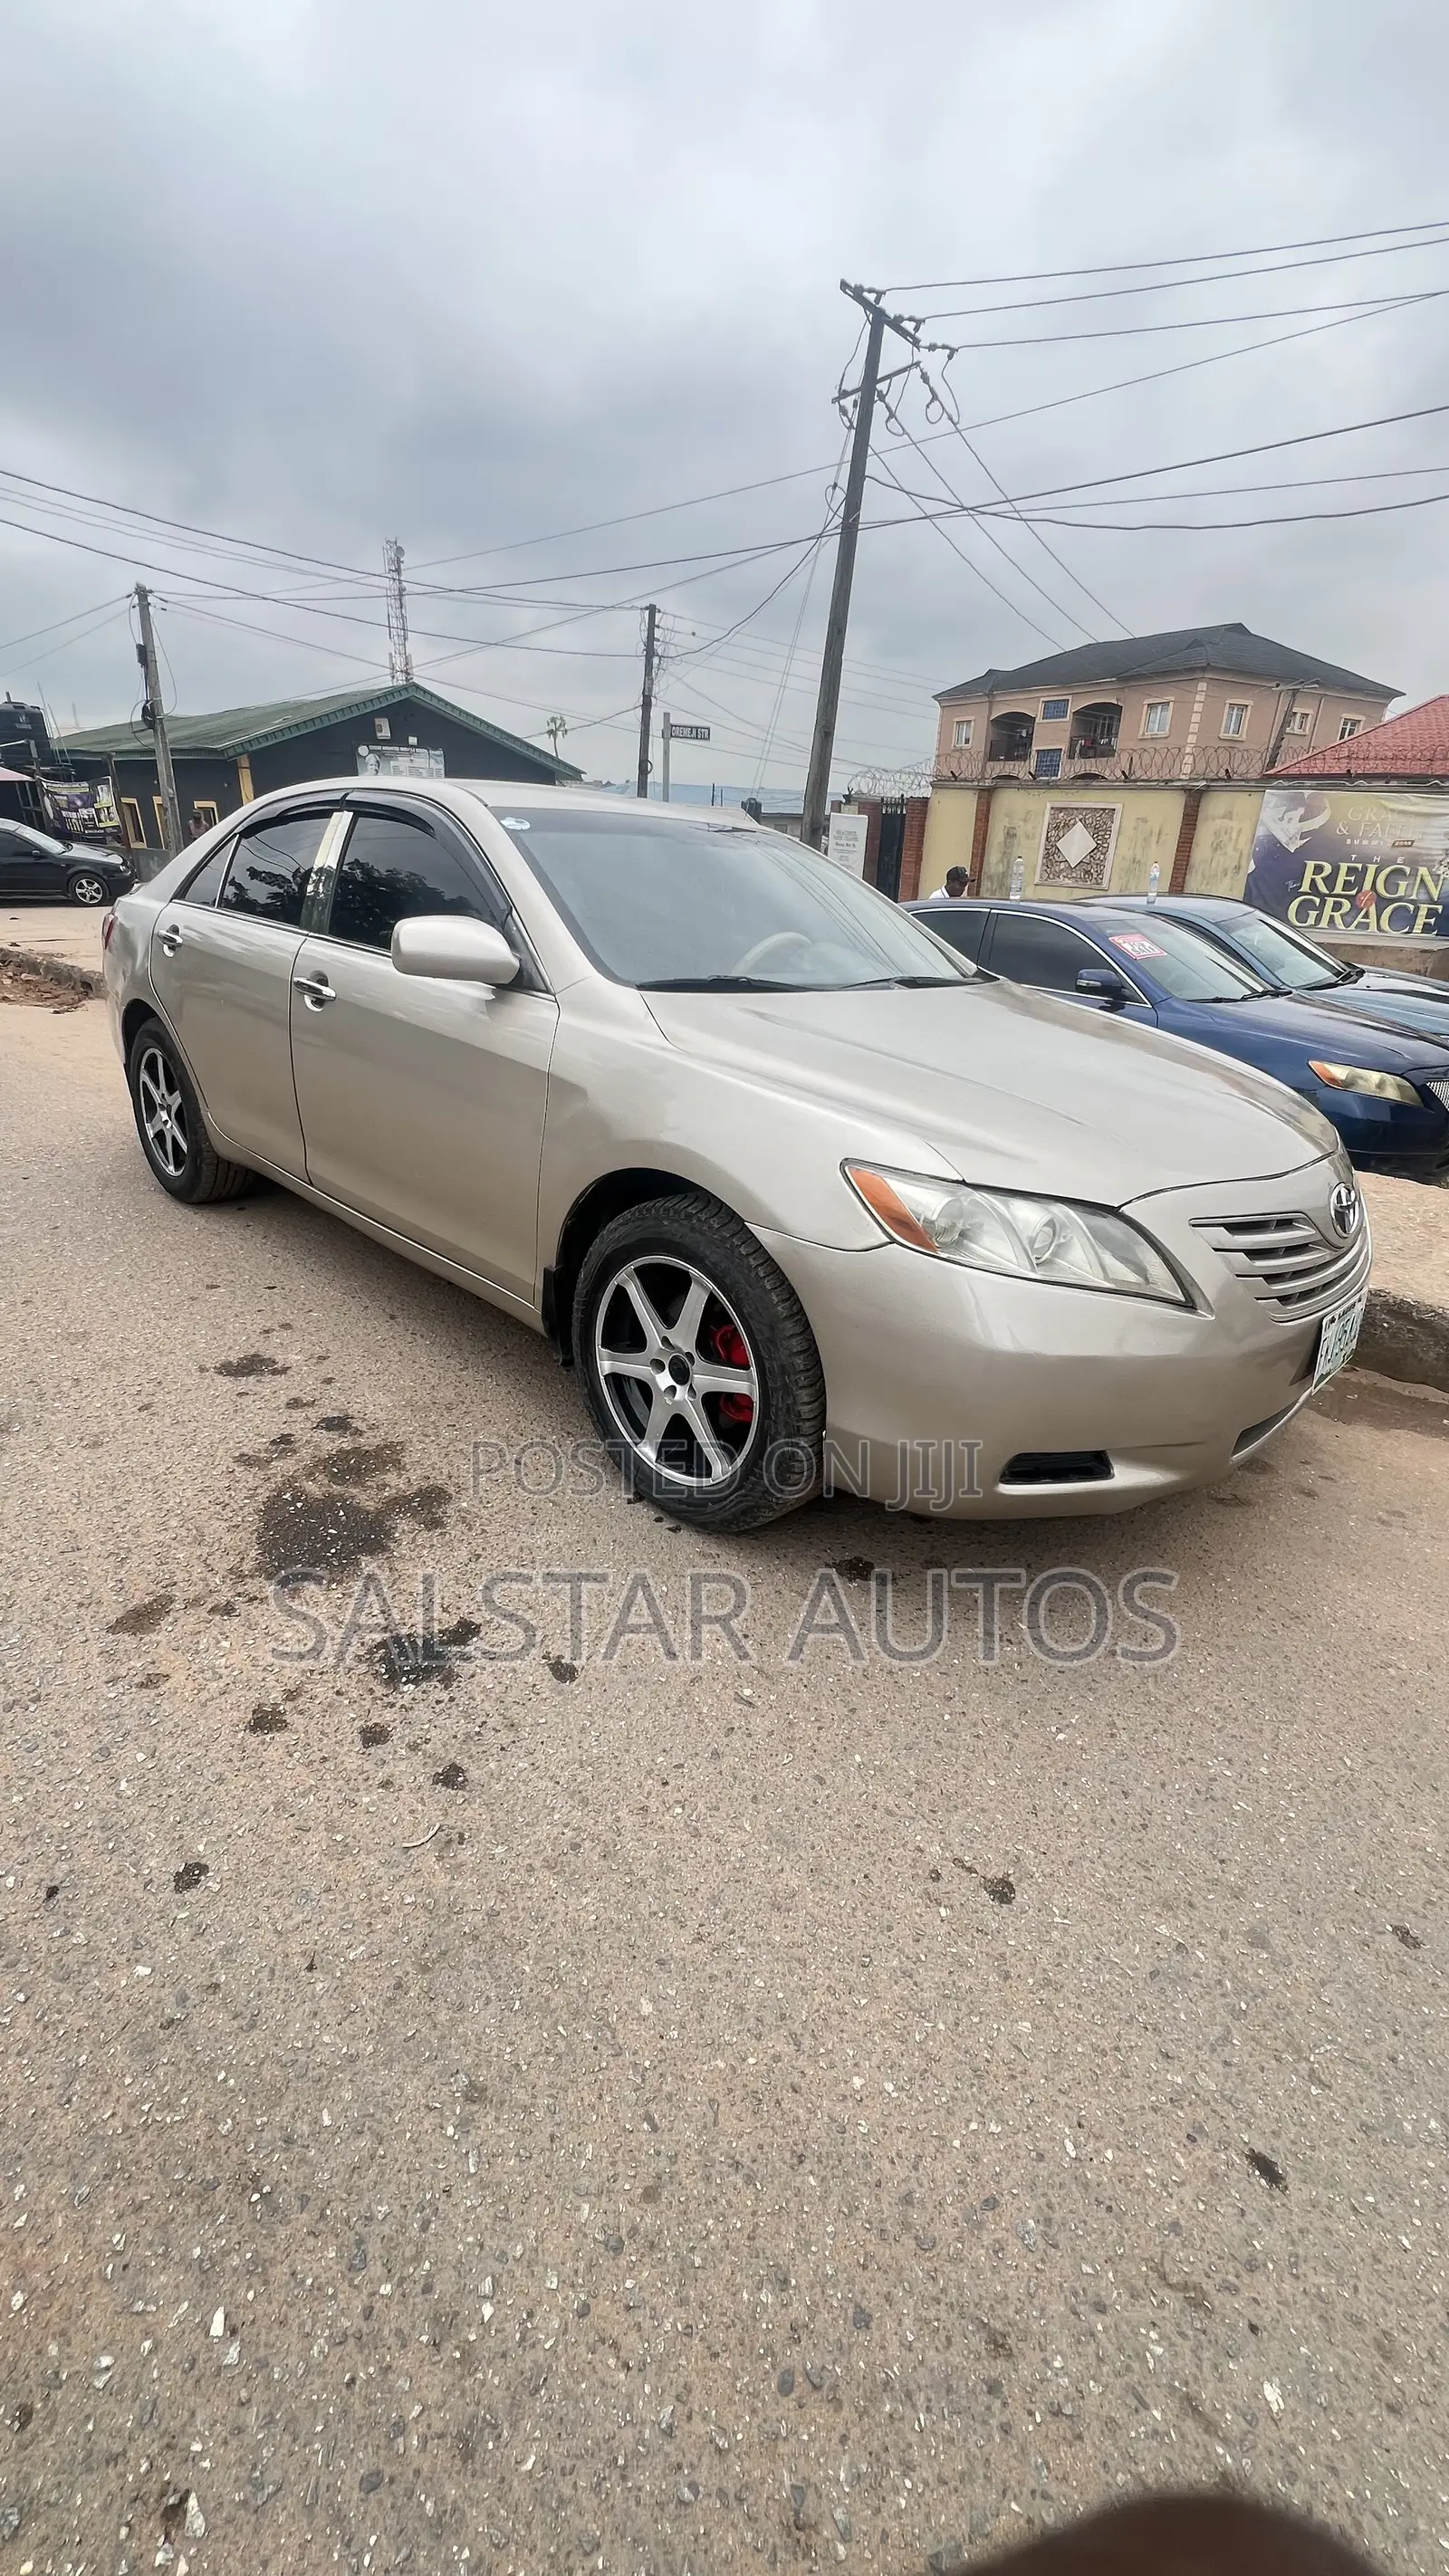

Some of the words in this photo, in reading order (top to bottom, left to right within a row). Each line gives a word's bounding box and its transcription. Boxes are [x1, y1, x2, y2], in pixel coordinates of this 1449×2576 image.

[671, 726, 696, 738] OREMEJI
[697, 728, 709, 739] STR
[1336, 820, 1349, 836] &
[1350, 854, 1406, 864] THE
[1298, 860, 1444, 902] REIGN
[1287, 895, 1443, 936] GRACE
